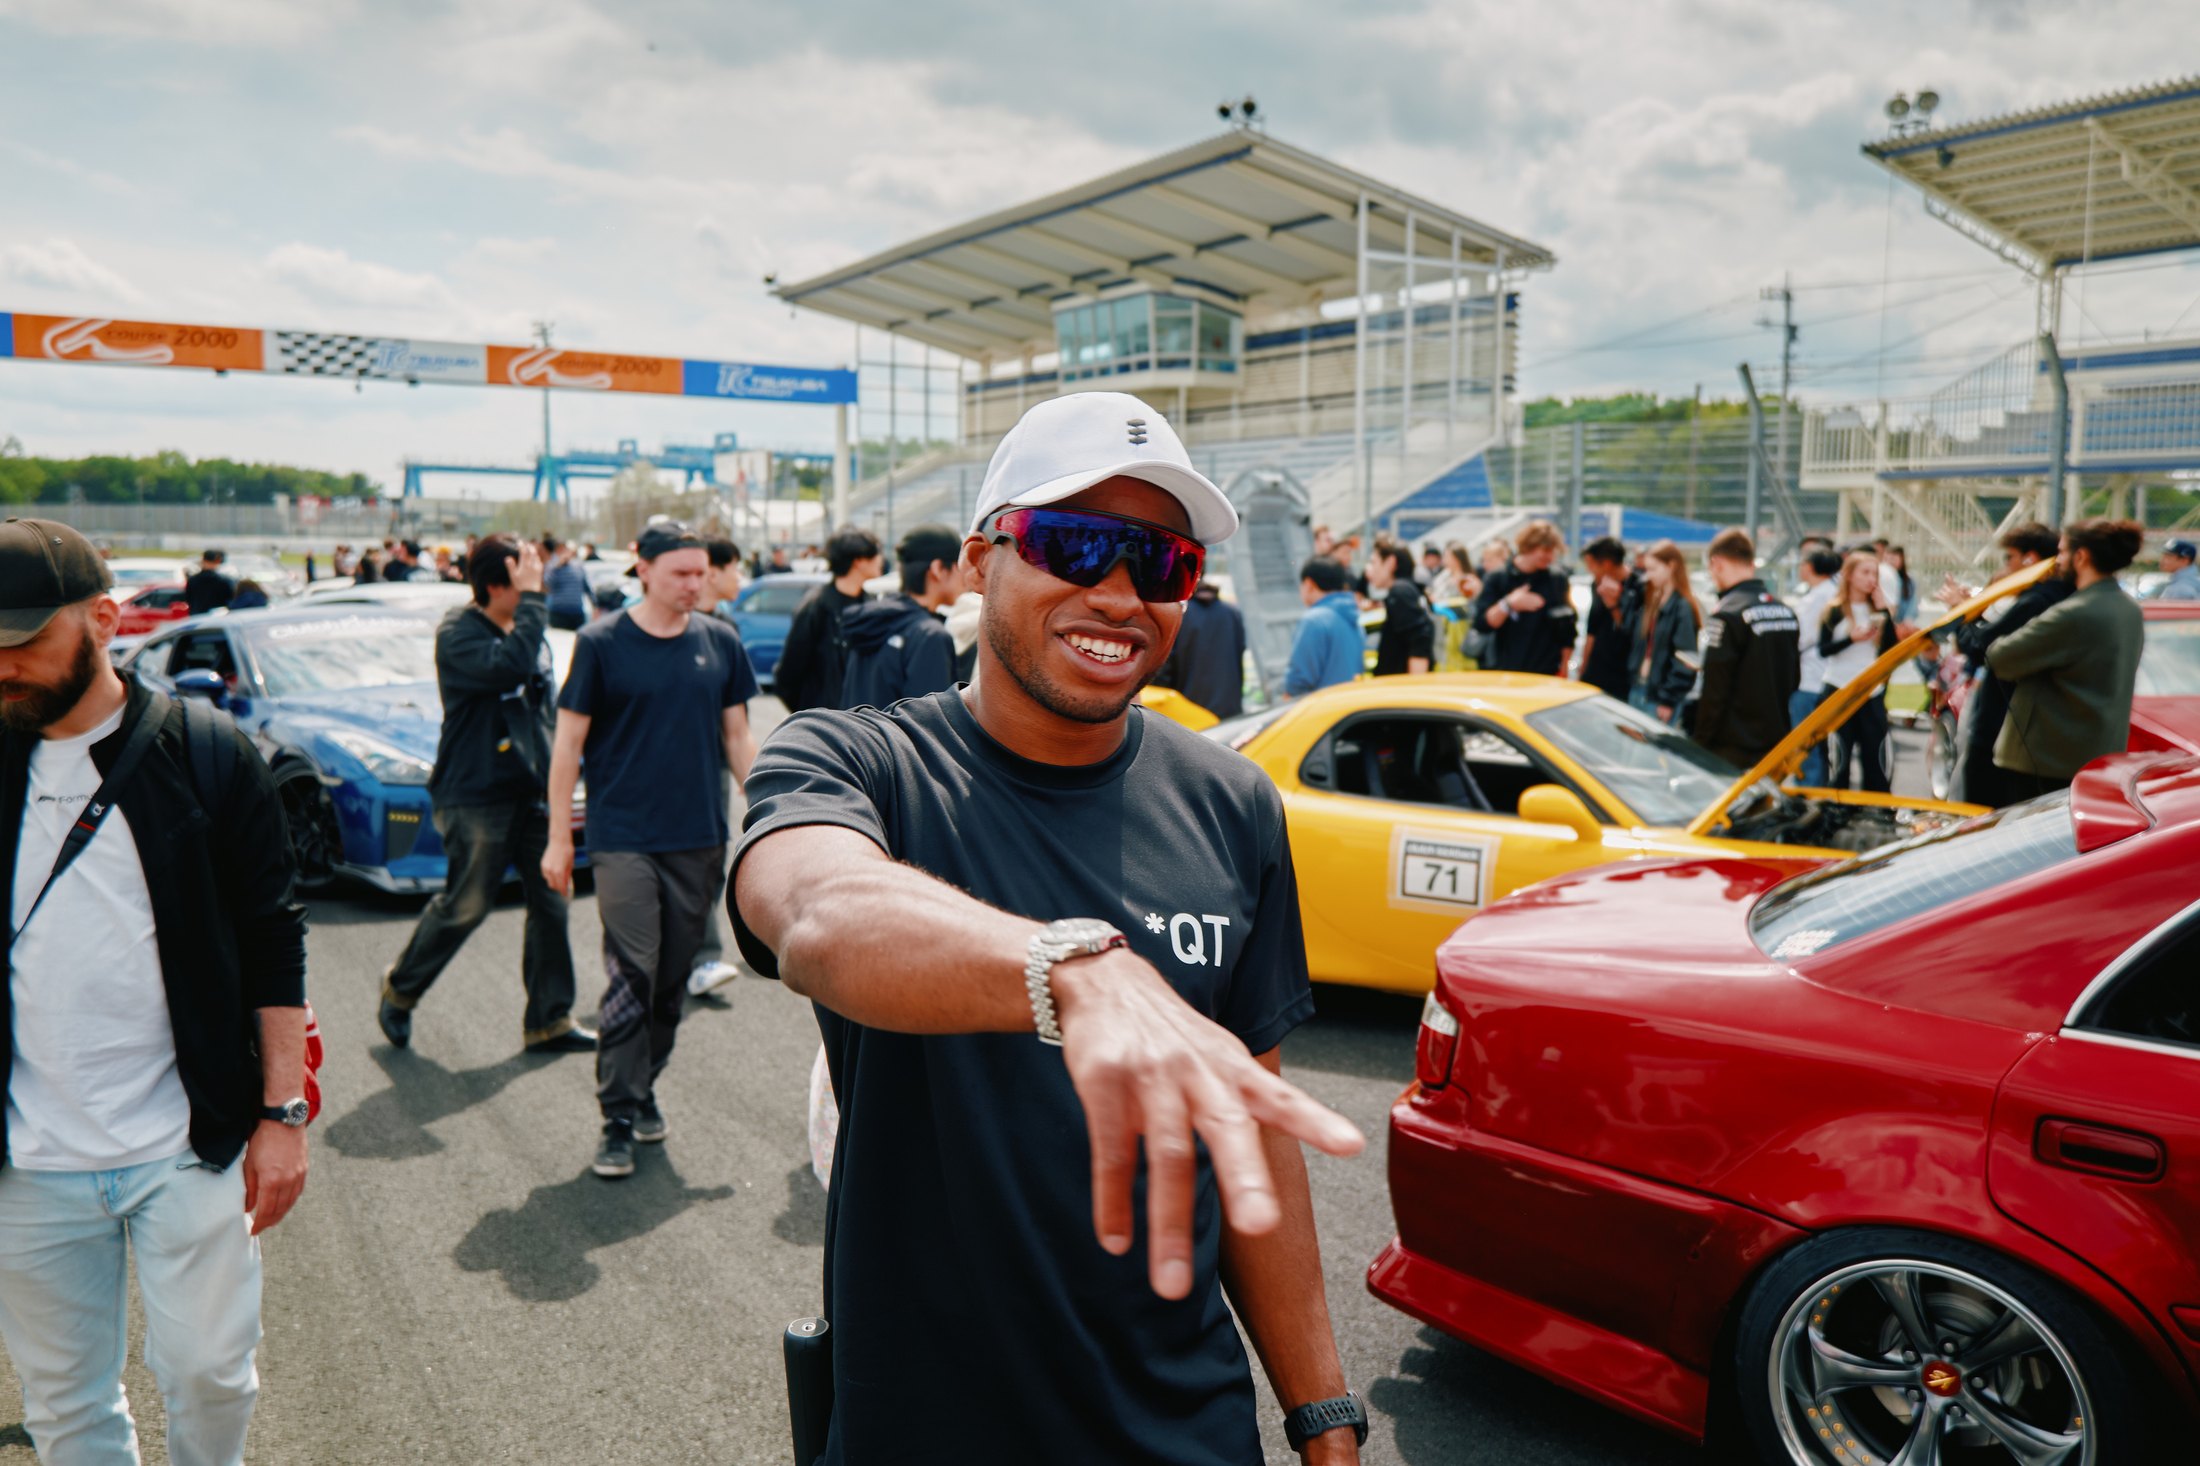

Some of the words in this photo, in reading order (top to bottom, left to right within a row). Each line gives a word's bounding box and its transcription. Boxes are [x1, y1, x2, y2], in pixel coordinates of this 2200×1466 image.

[173, 323, 239, 350] 2000
[611, 356, 662, 376] 2000
[1424, 863, 1458, 894] 71
